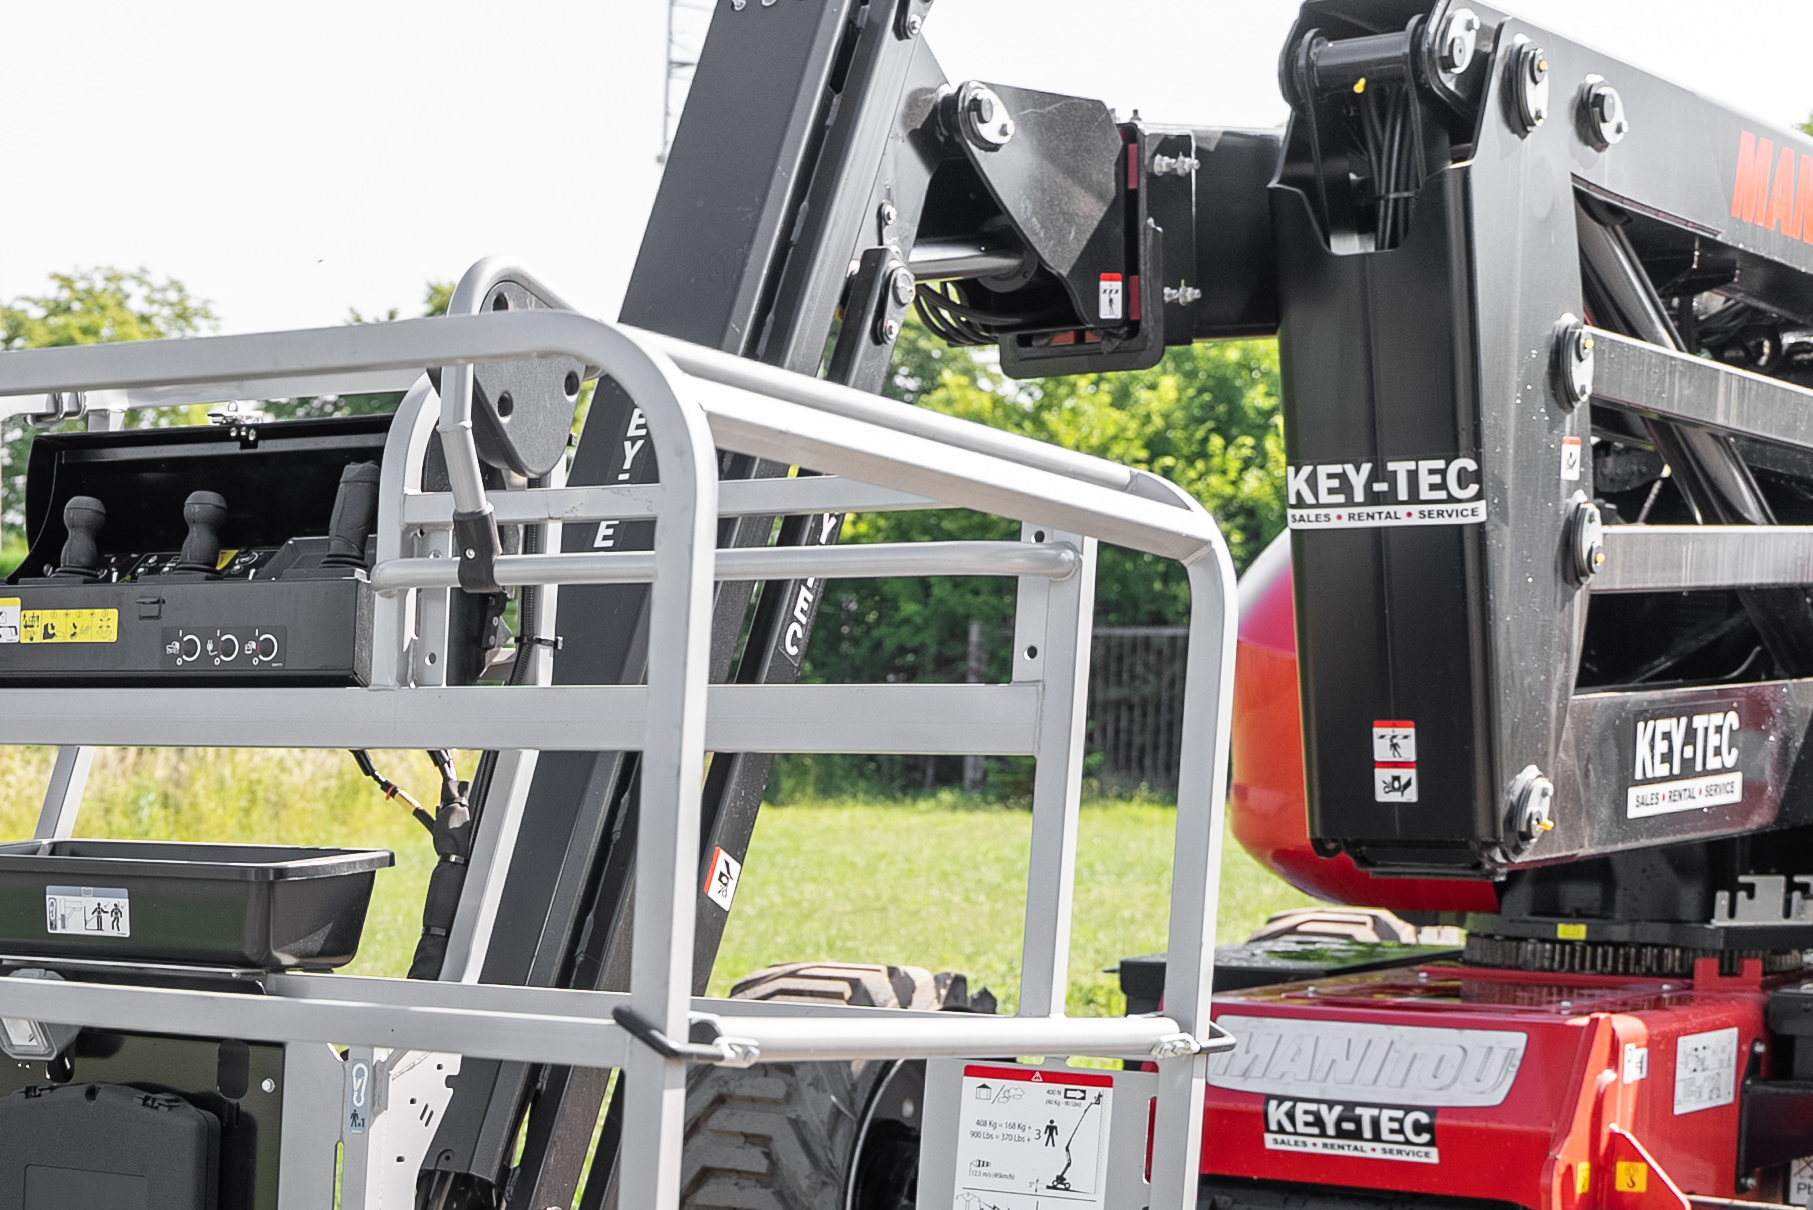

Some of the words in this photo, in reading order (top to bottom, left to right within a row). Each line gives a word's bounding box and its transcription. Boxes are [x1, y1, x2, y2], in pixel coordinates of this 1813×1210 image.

[1287, 458, 1480, 505] KEY-TEC
[1291, 513, 1331, 523] SALES
[1348, 511, 1401, 522] RENTAL
[1418, 507, 1479, 519] SERVICE
[1634, 711, 1740, 780] KEY-TEC
[1635, 792, 1660, 808] SALES
[1668, 787, 1696, 803] RENTAL
[1705, 780, 1735, 798] SERVICE
[1210, 1030, 1518, 1094] MANITOU
[1267, 1099, 1431, 1144] KEY-TEC
[1271, 1138, 1307, 1147] SALES
[1321, 1142, 1367, 1153] RENTAL
[1380, 1148, 1431, 1159] SERVICE
